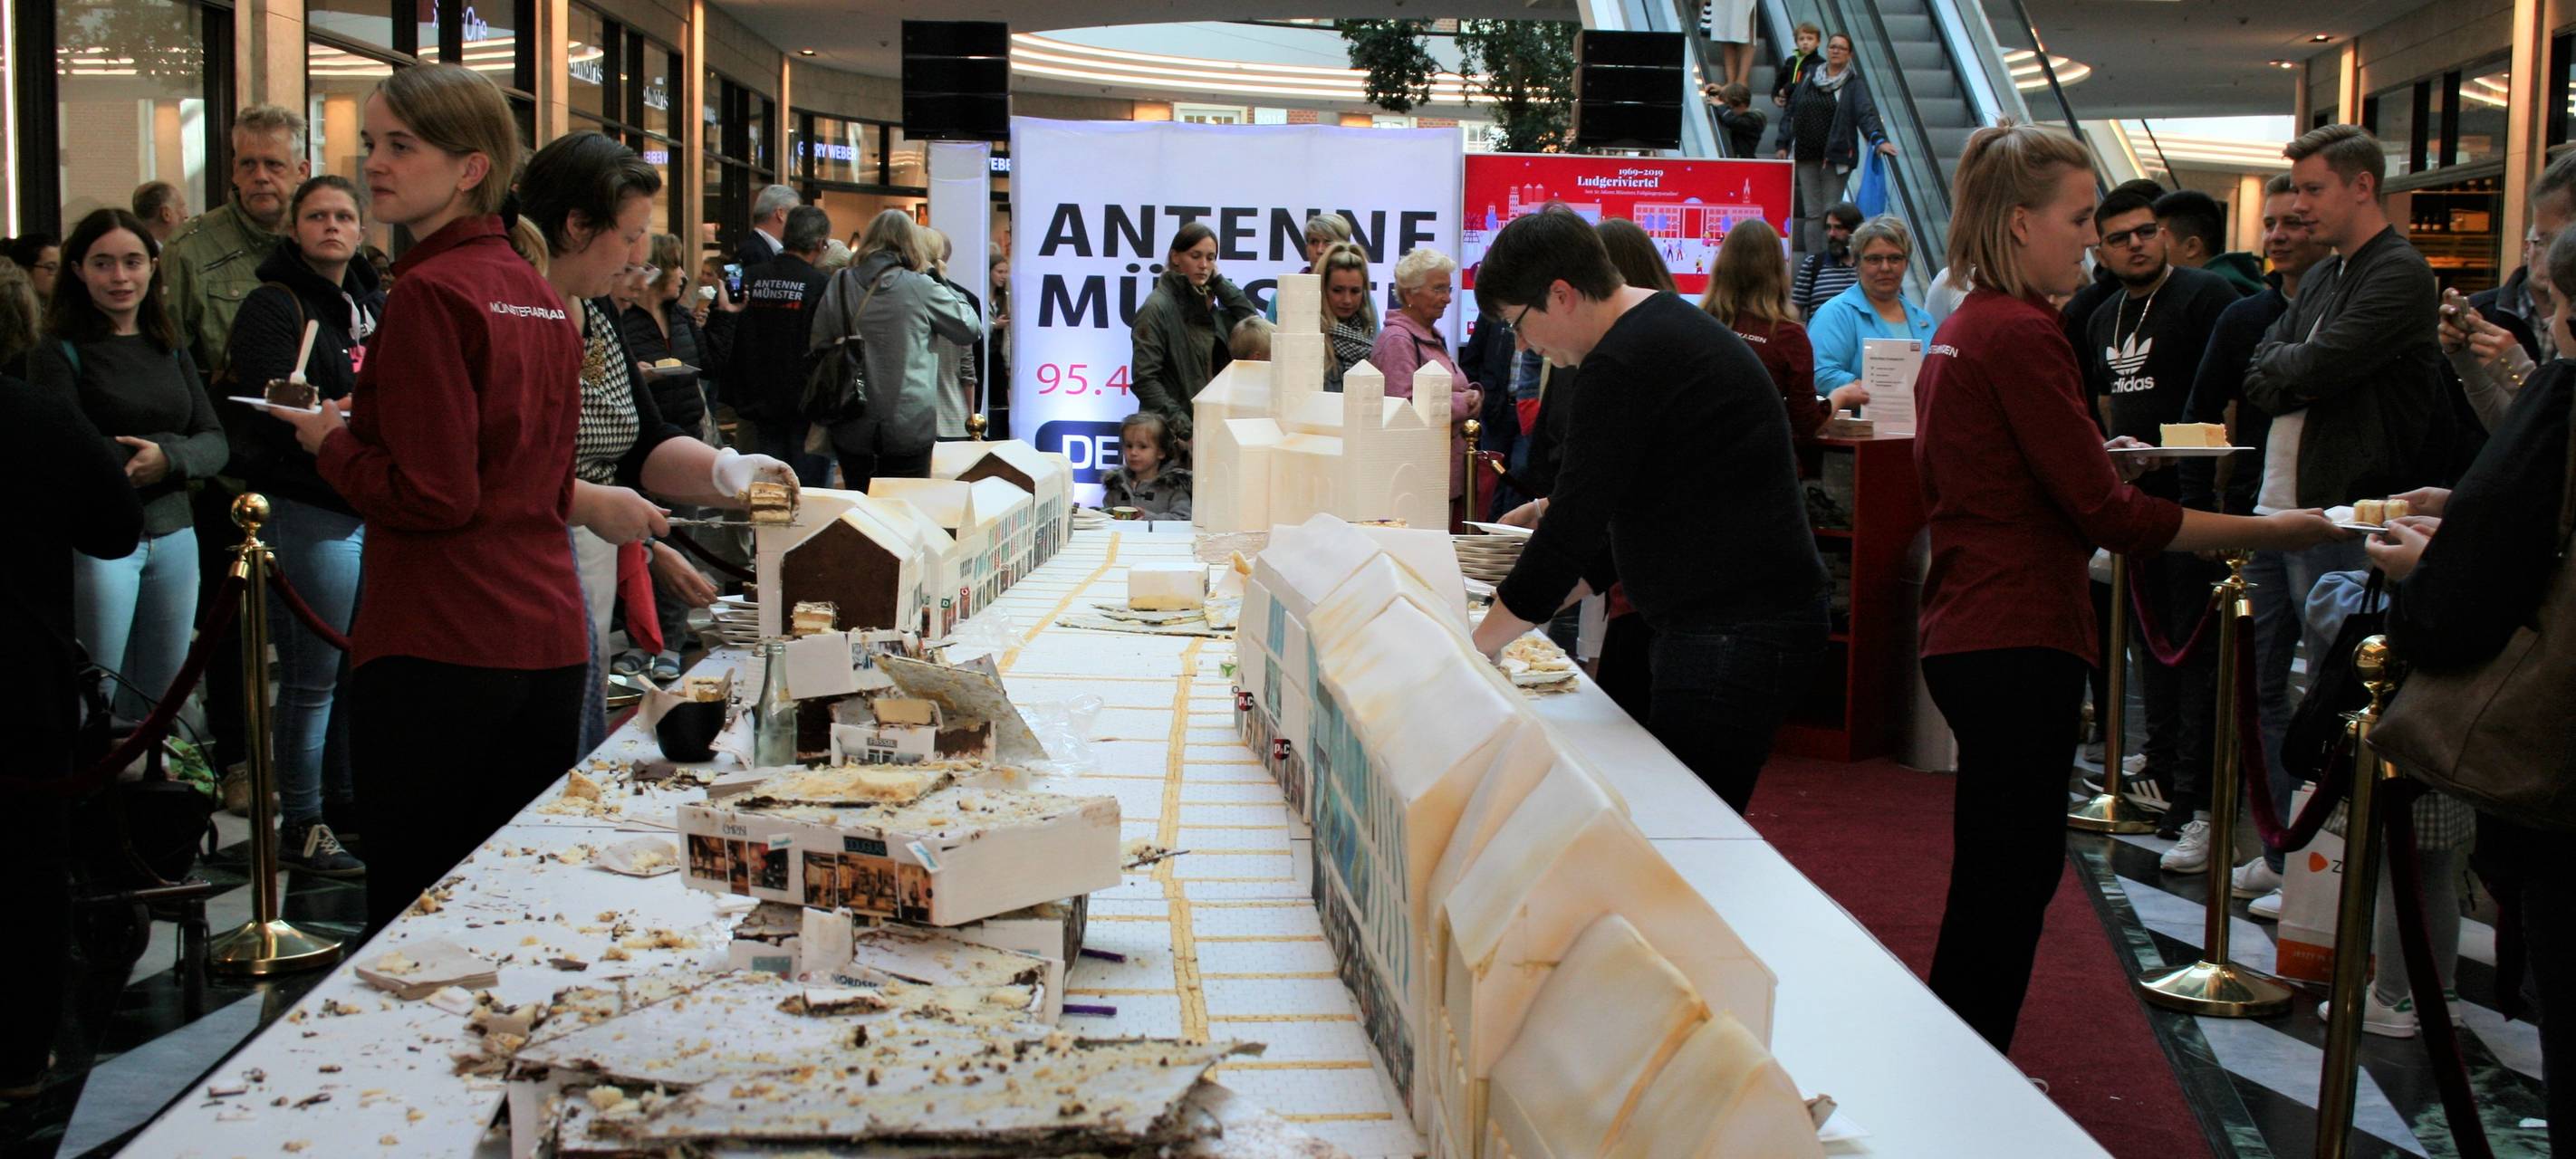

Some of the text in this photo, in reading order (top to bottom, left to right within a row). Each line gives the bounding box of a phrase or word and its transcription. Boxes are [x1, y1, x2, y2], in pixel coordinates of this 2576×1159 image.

[828, 144, 857, 160] WEBER
[1577, 176, 1658, 188] Ludgeriviertel
[1038, 203, 1437, 264] ANTENNE
[754, 279, 806, 292] ANTENNE
[752, 288, 803, 301] MÜNSTER
[1036, 363, 1130, 396] 95.4
